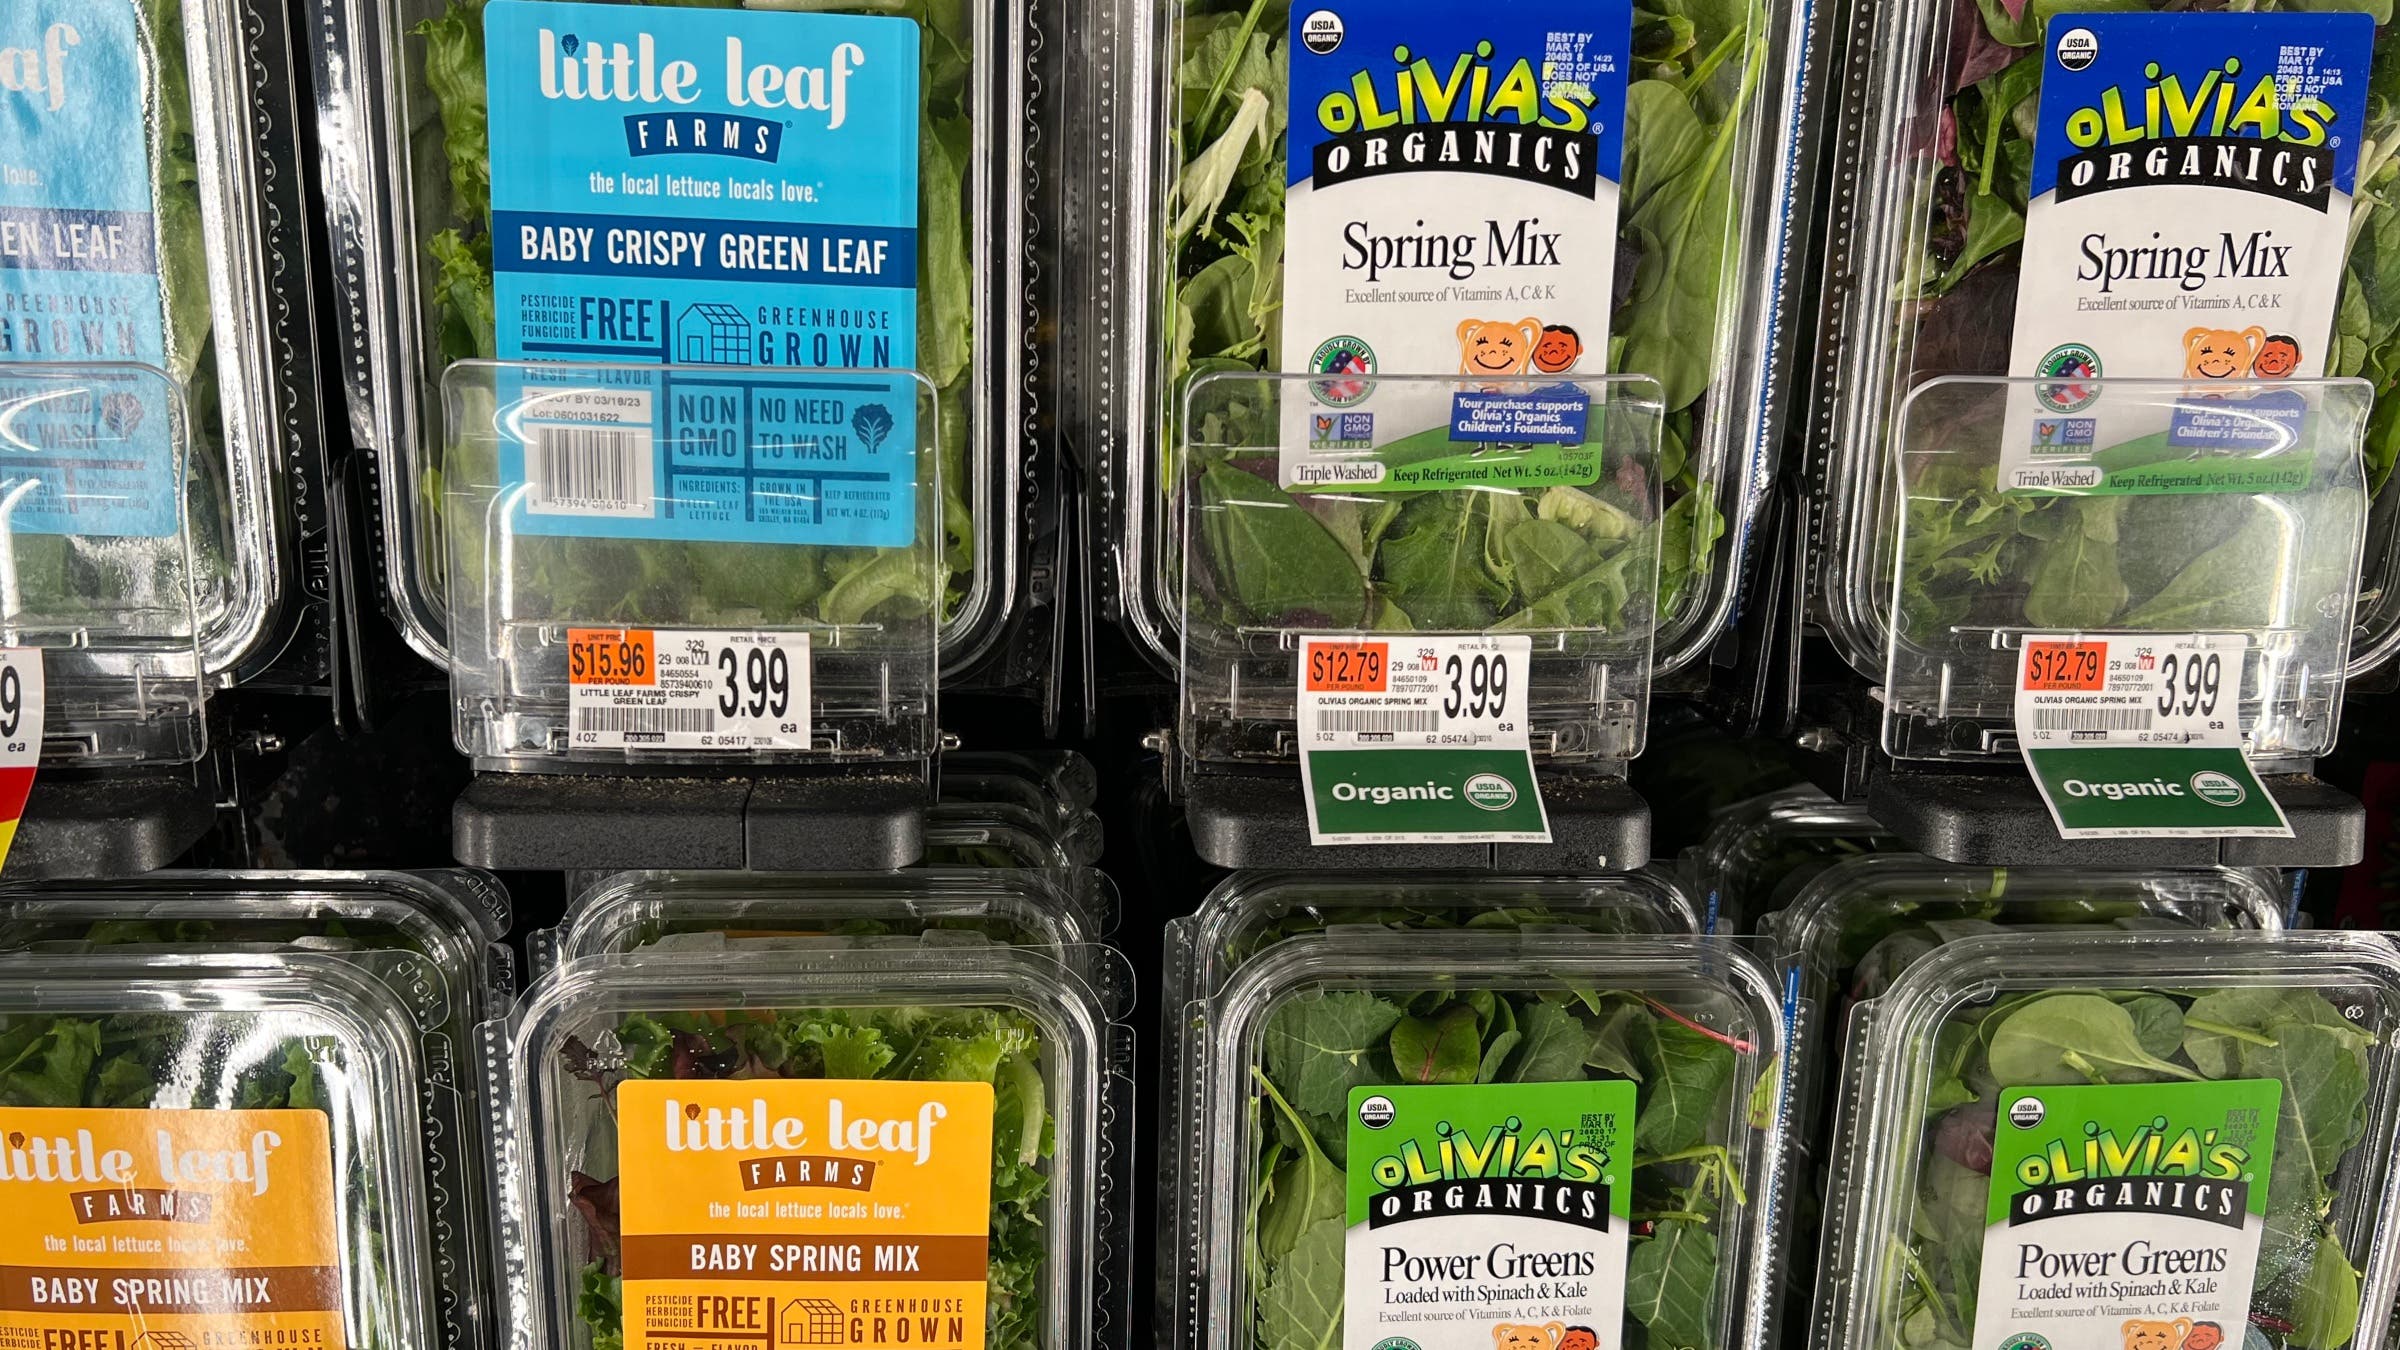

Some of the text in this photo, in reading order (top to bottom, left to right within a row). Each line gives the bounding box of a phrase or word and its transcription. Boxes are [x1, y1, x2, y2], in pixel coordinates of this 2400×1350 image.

[1311, 20, 1335, 31] USDA
[1307, 32, 1338, 44] ORGANIC
[1547, 32, 1593, 43] BEST BY
[2067, 37, 2090, 48] USDA
[1545, 43, 1584, 52] MAR 17
[2062, 50, 2092, 60] ORGANIC
[2280, 45, 2324, 57] BEST BY
[2278, 56, 2316, 65] MAR 17
[539, 29, 865, 130] little leaf
[1575, 72, 1597, 81] NOT
[2306, 75, 2320, 84] OF
[2322, 76, 2343, 85] USA
[638, 119, 769, 154] FARMS
[1327, 130, 1581, 180] ORGANICS
[2071, 144, 2317, 194] ORGANICS
[589, 172, 614, 194] the
[622, 173, 658, 196] local
[666, 174, 720, 198] lettuce
[728, 177, 773, 200] locals
[53, 224, 123, 259] LEAF
[521, 225, 888, 275] BABY CRISPY GREEN LEAF
[1343, 217, 1561, 281] Spring Mix
[2077, 230, 2292, 293] Spring Mix
[521, 294, 575, 309] PESTICIDE
[521, 309, 576, 325] HERBICIDE
[580, 297, 654, 342] FREE
[759, 306, 889, 330] GREENHOUSE
[522, 324, 576, 340] FUNGICIDE
[759, 330, 890, 368] GROWN
[678, 395, 736, 425] NON
[760, 398, 844, 425] NO NEED
[1459, 397, 1583, 413] Your purchase supports
[1344, 415, 1370, 424] NON
[1472, 410, 1560, 424] Olivia's Organics
[2192, 415, 2232, 426] Olivia's
[1343, 424, 1370, 432] GMO
[2065, 429, 2093, 437] GMO
[2177, 426, 2229, 438] Children's
[680, 429, 737, 457] GMO
[760, 433, 847, 461] TO WASH
[1297, 463, 1378, 485] Triple Washed
[2015, 468, 2095, 489] Triple Washed
[572, 639, 645, 681] $15.96
[1313, 650, 1379, 682] $12.79
[2031, 649, 2097, 684] $12.79
[718, 647, 789, 718] 3.99
[1444, 654, 1507, 719] 3.99
[2158, 653, 2220, 717] 3.99
[613, 689, 634, 697] LEAF
[637, 690, 666, 698] FARMS
[669, 690, 700, 698] CRISPY
[1318, 697, 1346, 705] OLIVIAS
[1349, 698, 1382, 706] ORGANIC
[2034, 696, 2063, 704] OLIVIAS
[2065, 696, 2097, 704] ORGANIC
[2099, 696, 2127, 704] SPRING
[780, 723, 797, 733] ea
[1498, 722, 1514, 731] ea
[2209, 721, 2224, 729] ea
[584, 733, 597, 742] OZ
[701, 736, 713, 745] 62
[719, 736, 747, 745] 05417
[1426, 735, 1436, 743] 62
[1441, 735, 1467, 744] 05474
[2139, 733, 2148, 741] 62
[2153, 733, 2178, 741] 05474
[8, 742, 26, 752] ea
[1332, 781, 1455, 805] Organic
[2063, 778, 2185, 800] Organic
[1367, 1103, 1388, 1112] USDA
[2017, 1104, 2037, 1113] USDA
[665, 1098, 947, 1166] little leaf
[751, 1160, 864, 1185] FARMS
[84, 1193, 200, 1219] FARMS
[1382, 1183, 1596, 1219] ORGANICS
[2023, 1181, 2233, 1216] ORGANICS
[709, 1202, 730, 1218] the
[737, 1202, 769, 1218] local
[775, 1202, 822, 1218] lettuce
[828, 1202, 867, 1219] locals
[691, 1244, 920, 1272] BABY SPRING MIX
[1380, 1243, 1595, 1282] Power Greens
[2015, 1240, 2227, 1279] Power Greens
[31, 1277, 271, 1305] BABY SPRING MIX
[1384, 1282, 1588, 1305] Loaded with Spinach & Kale
[2018, 1278, 2217, 1301] Loaded with Spinach & Kale
[646, 1295, 693, 1306] PESTICIDE
[851, 1298, 963, 1313] GREENHOUSE
[646, 1306, 693, 1317] HERBICIDE
[697, 1296, 761, 1329] FREE
[1379, 1309, 1422, 1323] Excellent
[1423, 1311, 1454, 1321] source
[1455, 1309, 1468, 1321] of
[1468, 1308, 1511, 1321] Vitamins
[1540, 1306, 1550, 1317] K
[1562, 1305, 1592, 1317] Folate
[646, 1318, 693, 1329] FUNGICIDE
[850, 1317, 963, 1343] GROWN
[203, 1328, 322, 1344] GREENHOUSE
